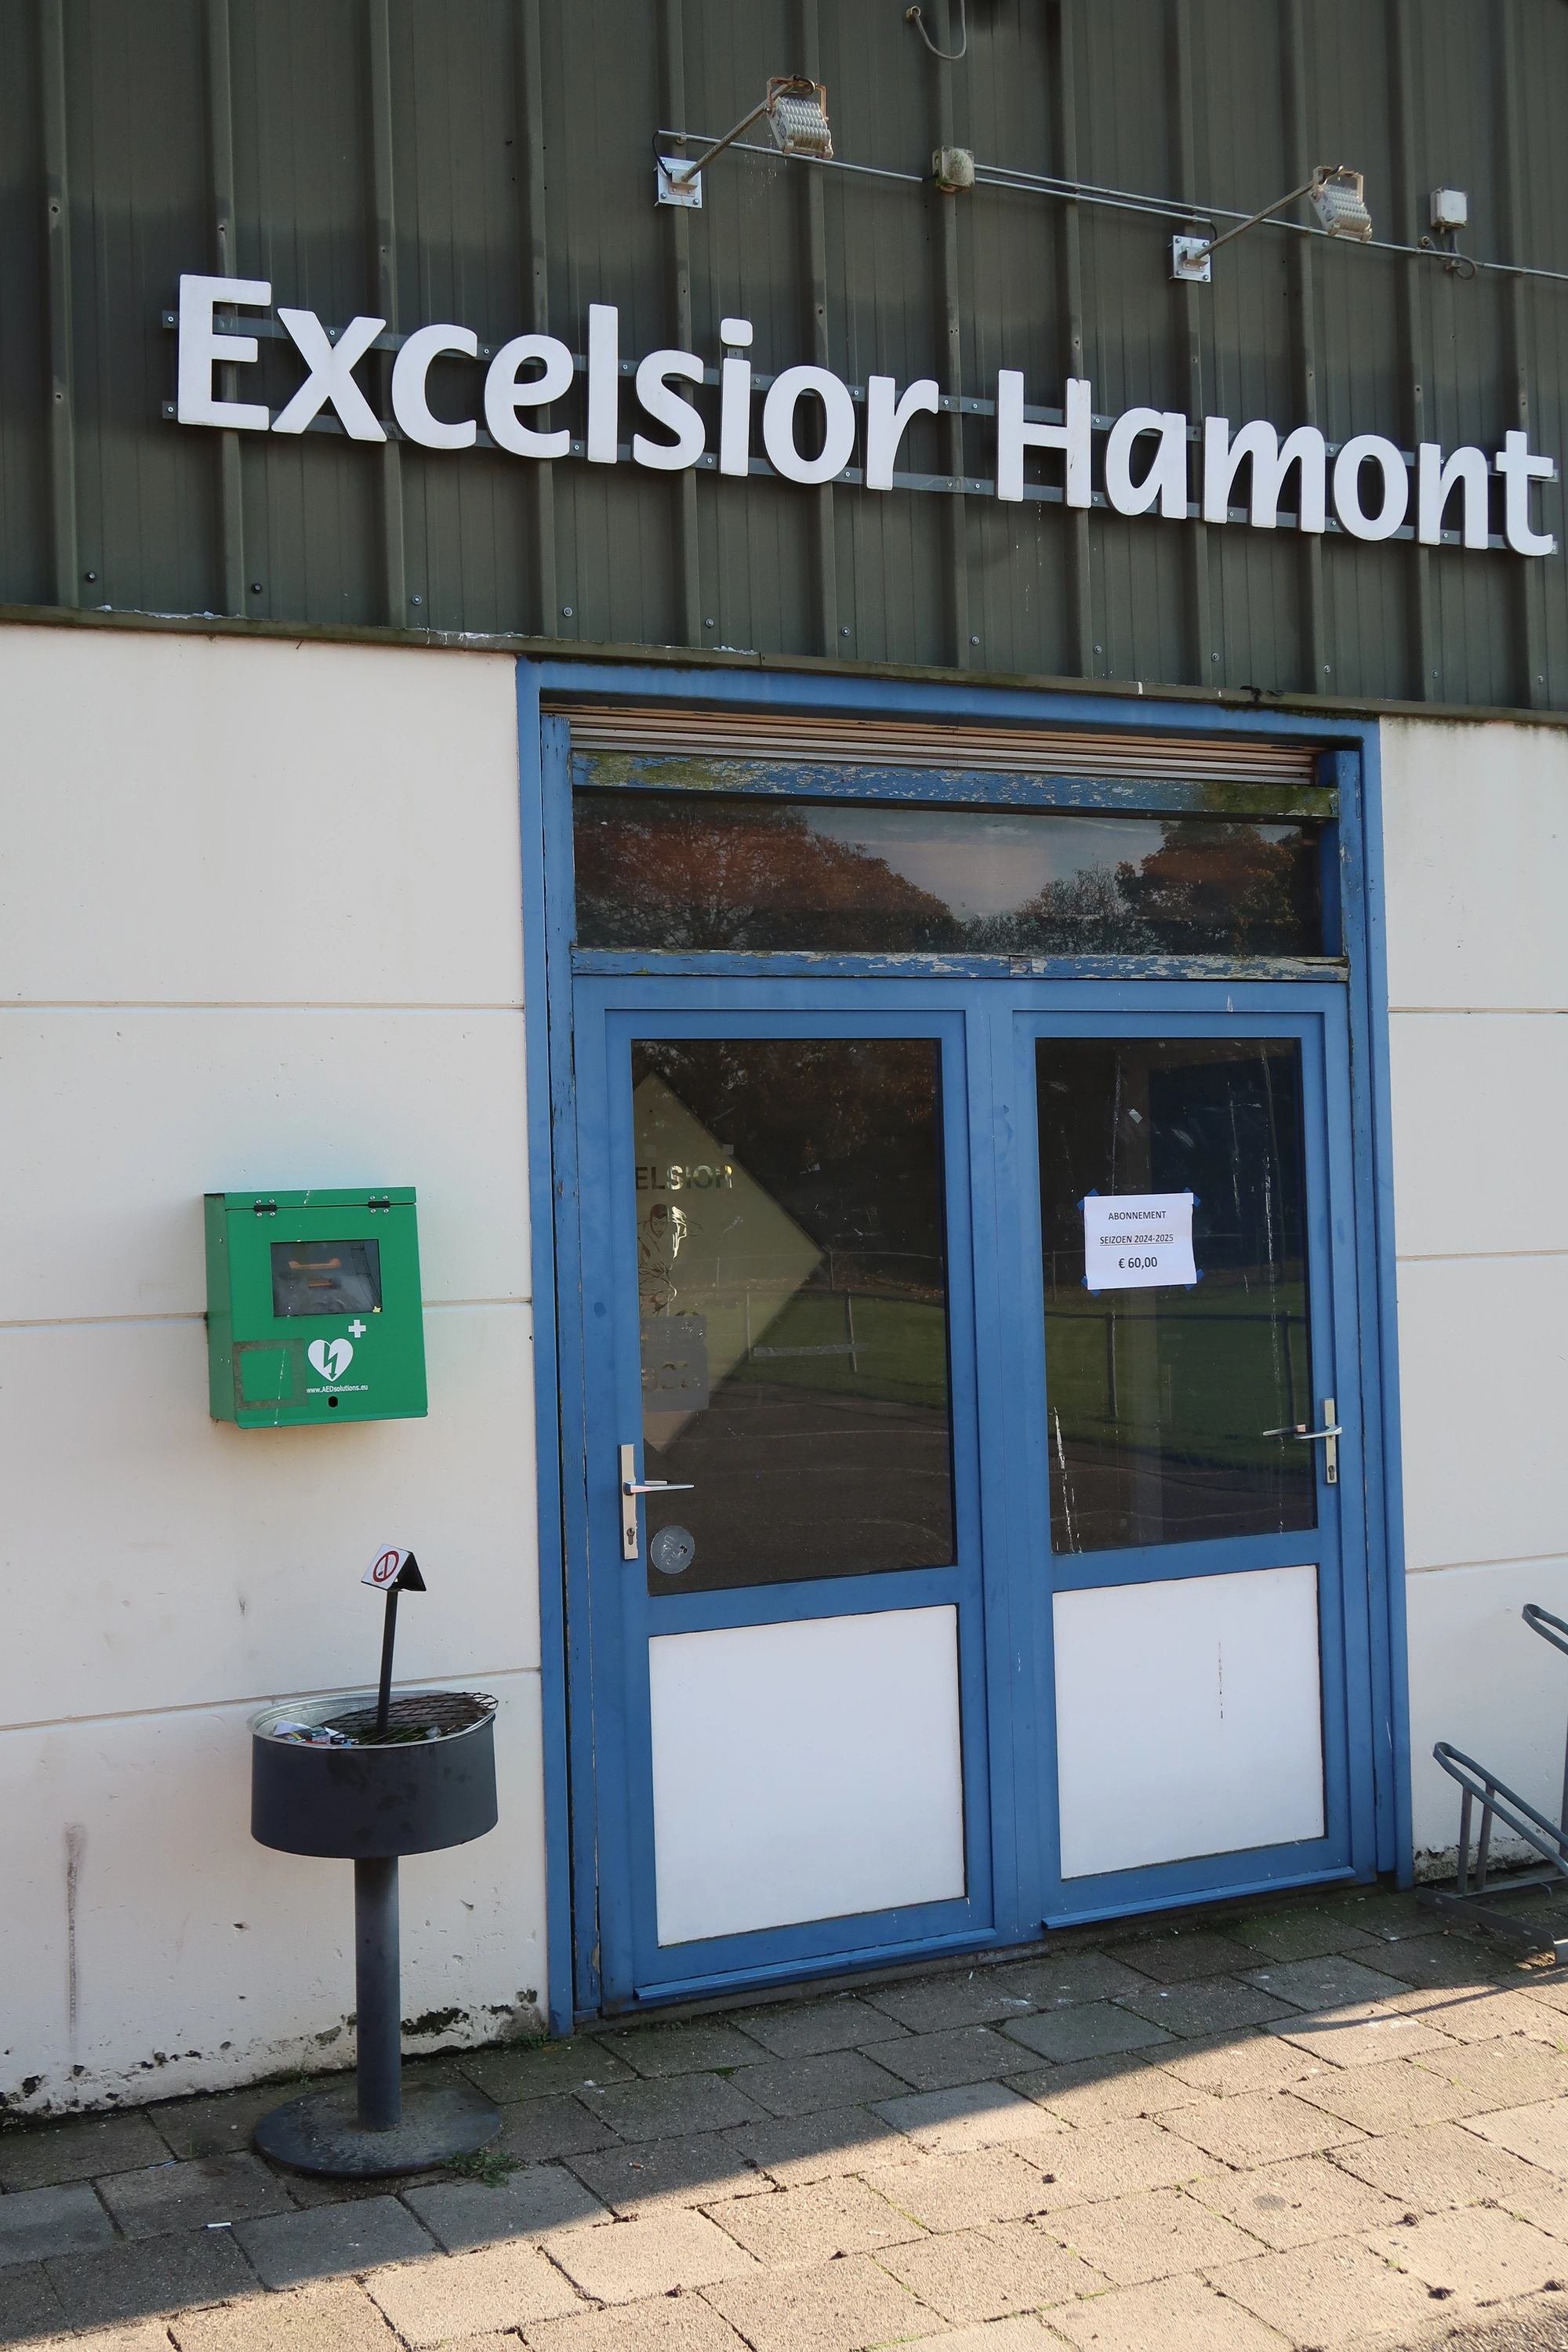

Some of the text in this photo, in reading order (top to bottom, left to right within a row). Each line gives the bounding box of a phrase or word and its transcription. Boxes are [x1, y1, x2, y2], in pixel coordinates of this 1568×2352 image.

[177, 274, 1554, 557] Excelsior Hamont
[1108, 1210, 1167, 1221] ABONNEMENT
[1099, 1233, 1174, 1244] SEIZOEN 2024-2025
[1118, 1257, 1158, 1270] € 60,00
[306, 1385, 368, 1393] www.AEDsolutions.eu
